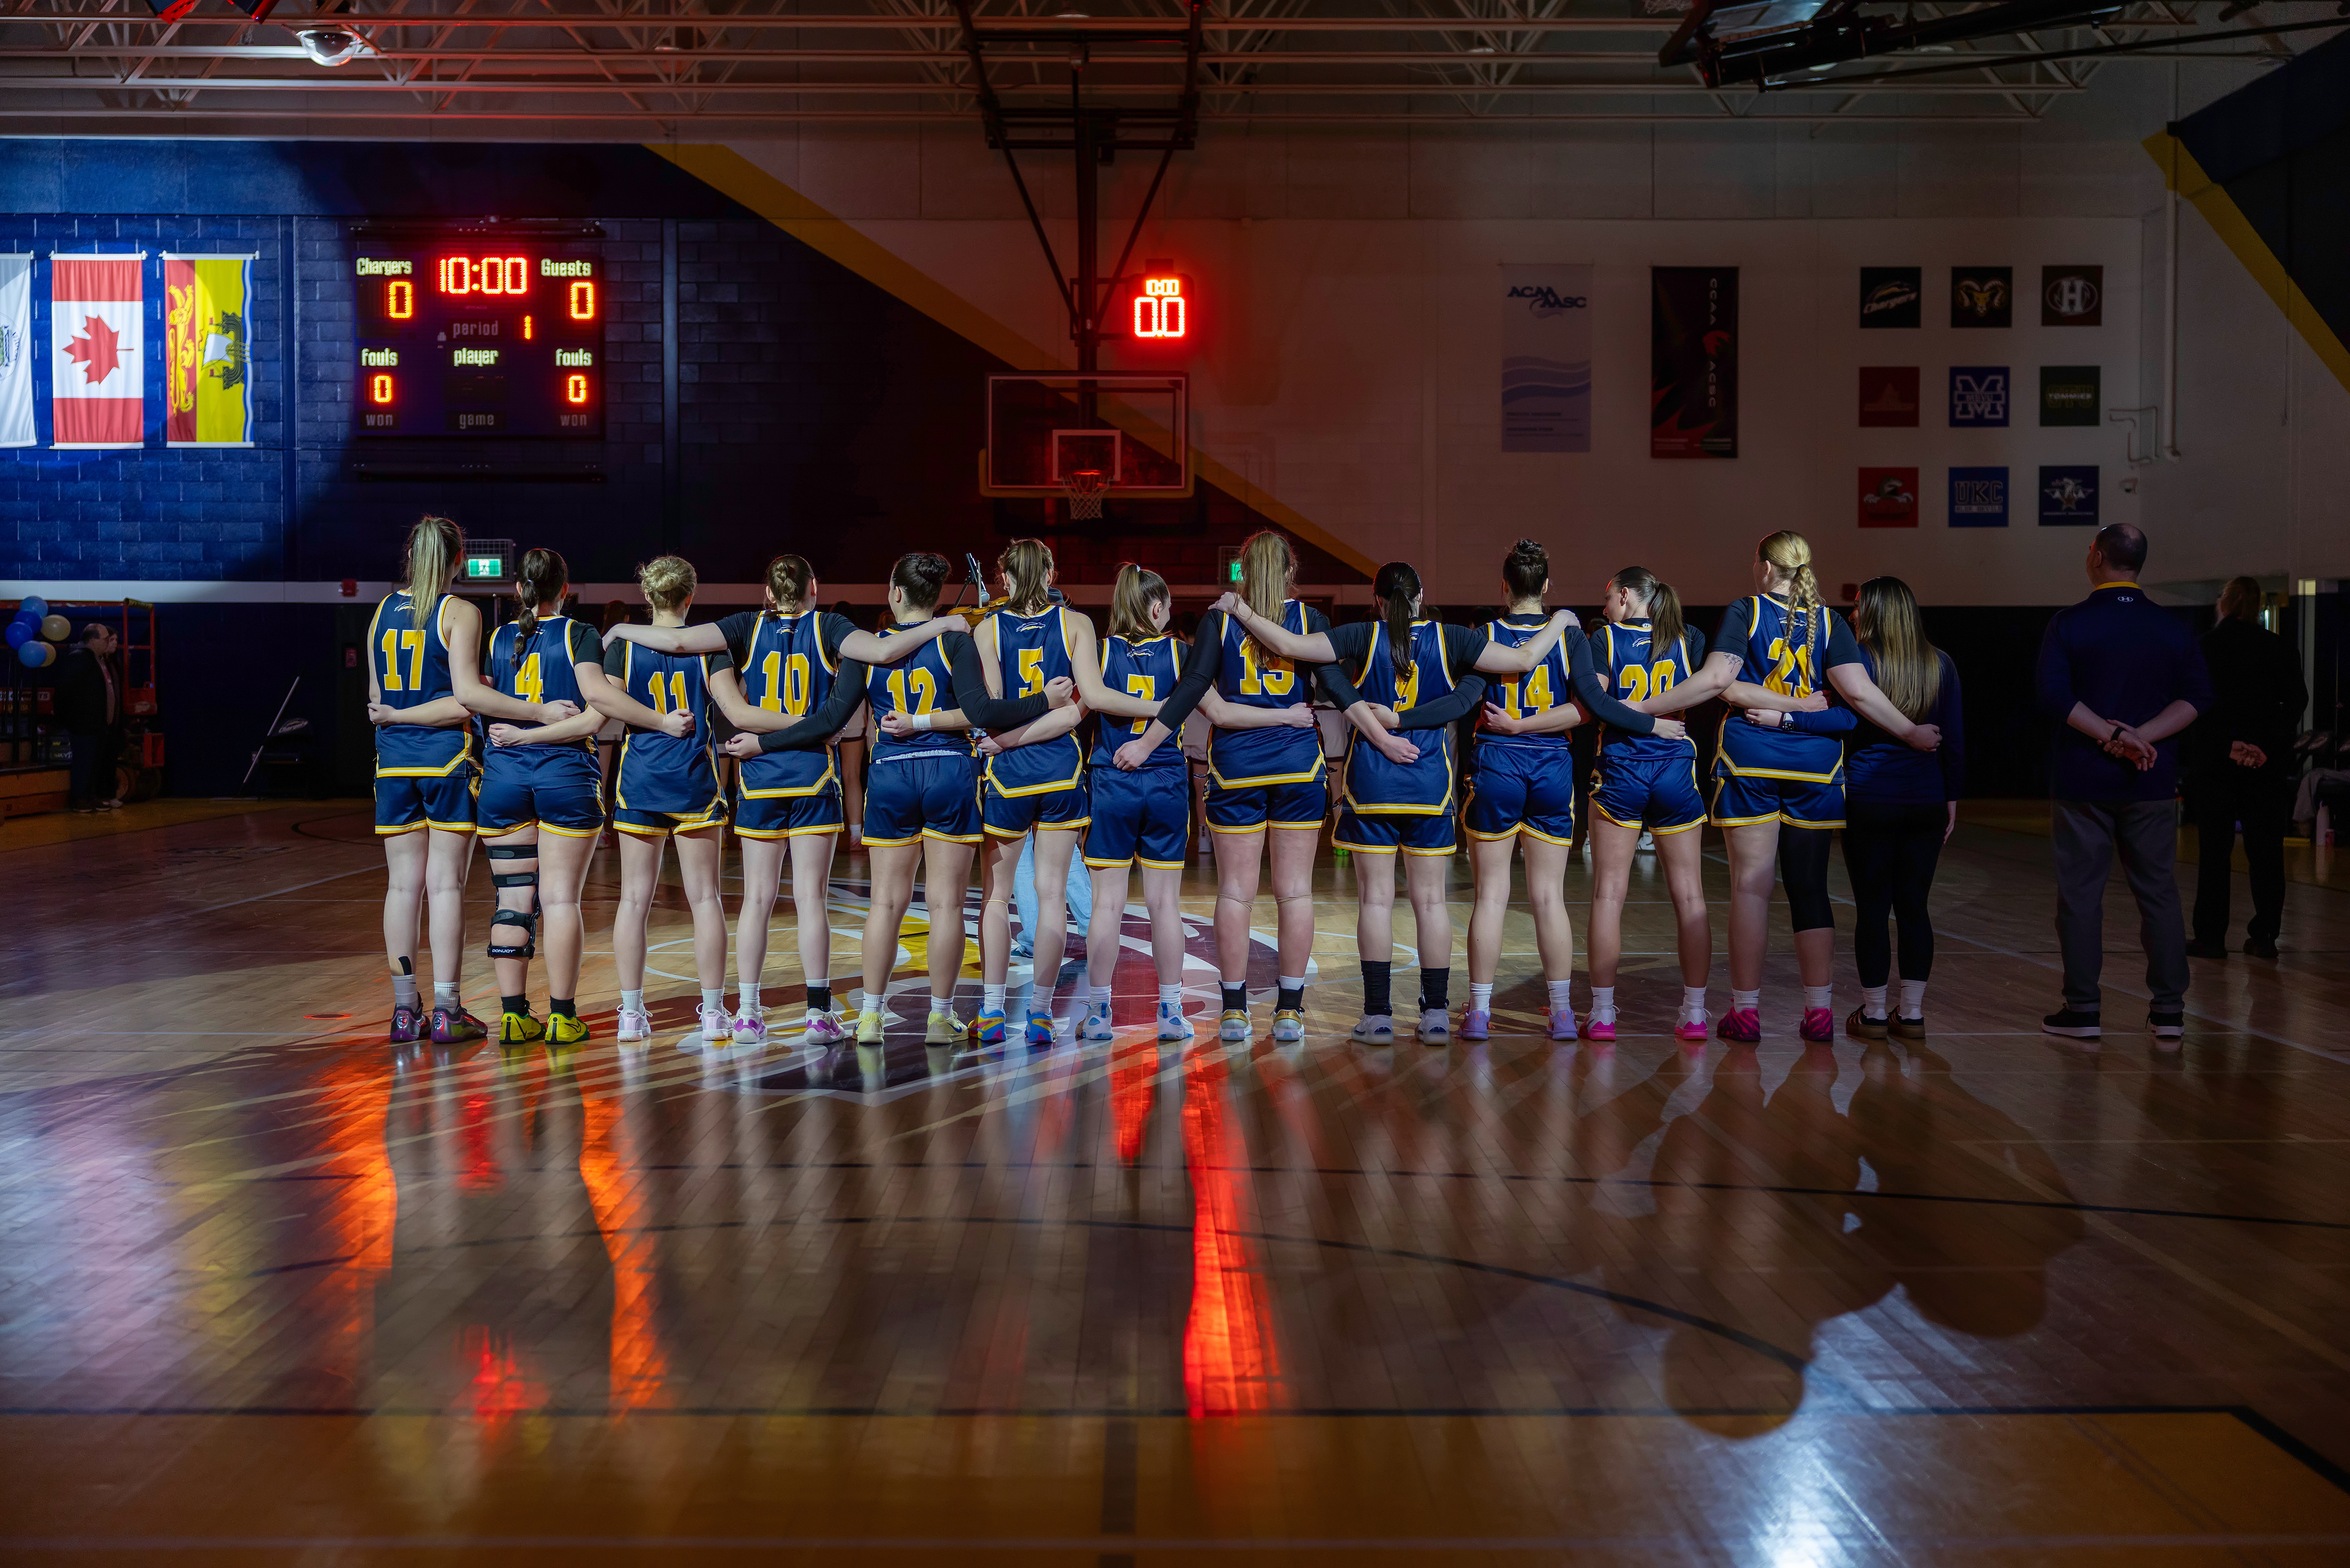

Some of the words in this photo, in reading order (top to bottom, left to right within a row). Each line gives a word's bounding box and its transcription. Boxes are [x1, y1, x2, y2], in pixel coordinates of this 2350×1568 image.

[356, 257, 412, 276] Chargers
[439, 257, 528, 295] 10:00
[540, 258, 592, 277] Guests
[388, 280, 413, 319] 0
[569, 281, 594, 320] 0
[1507, 286, 1556, 298] ACAA
[1709, 277, 1718, 325] CCAA
[452, 320, 499, 339] period
[524, 315, 533, 339] 1
[361, 348, 398, 367] fouls
[453, 348, 499, 368] player
[555, 348, 593, 367] fouls
[373, 375, 392, 403] 0
[568, 375, 587, 403] 0
[365, 414, 393, 427] won
[459, 413, 495, 430] game
[560, 414, 587, 427] won
[1955, 481, 2004, 504] UKC
[382, 629, 426, 691] 17
[1018, 646, 1044, 698] 5
[514, 652, 544, 704] 4
[760, 651, 811, 717] 10
[886, 667, 942, 715] 12
[1500, 664, 1554, 720] 14
[648, 671, 690, 715] 11
[1127, 674, 1155, 734] 7
